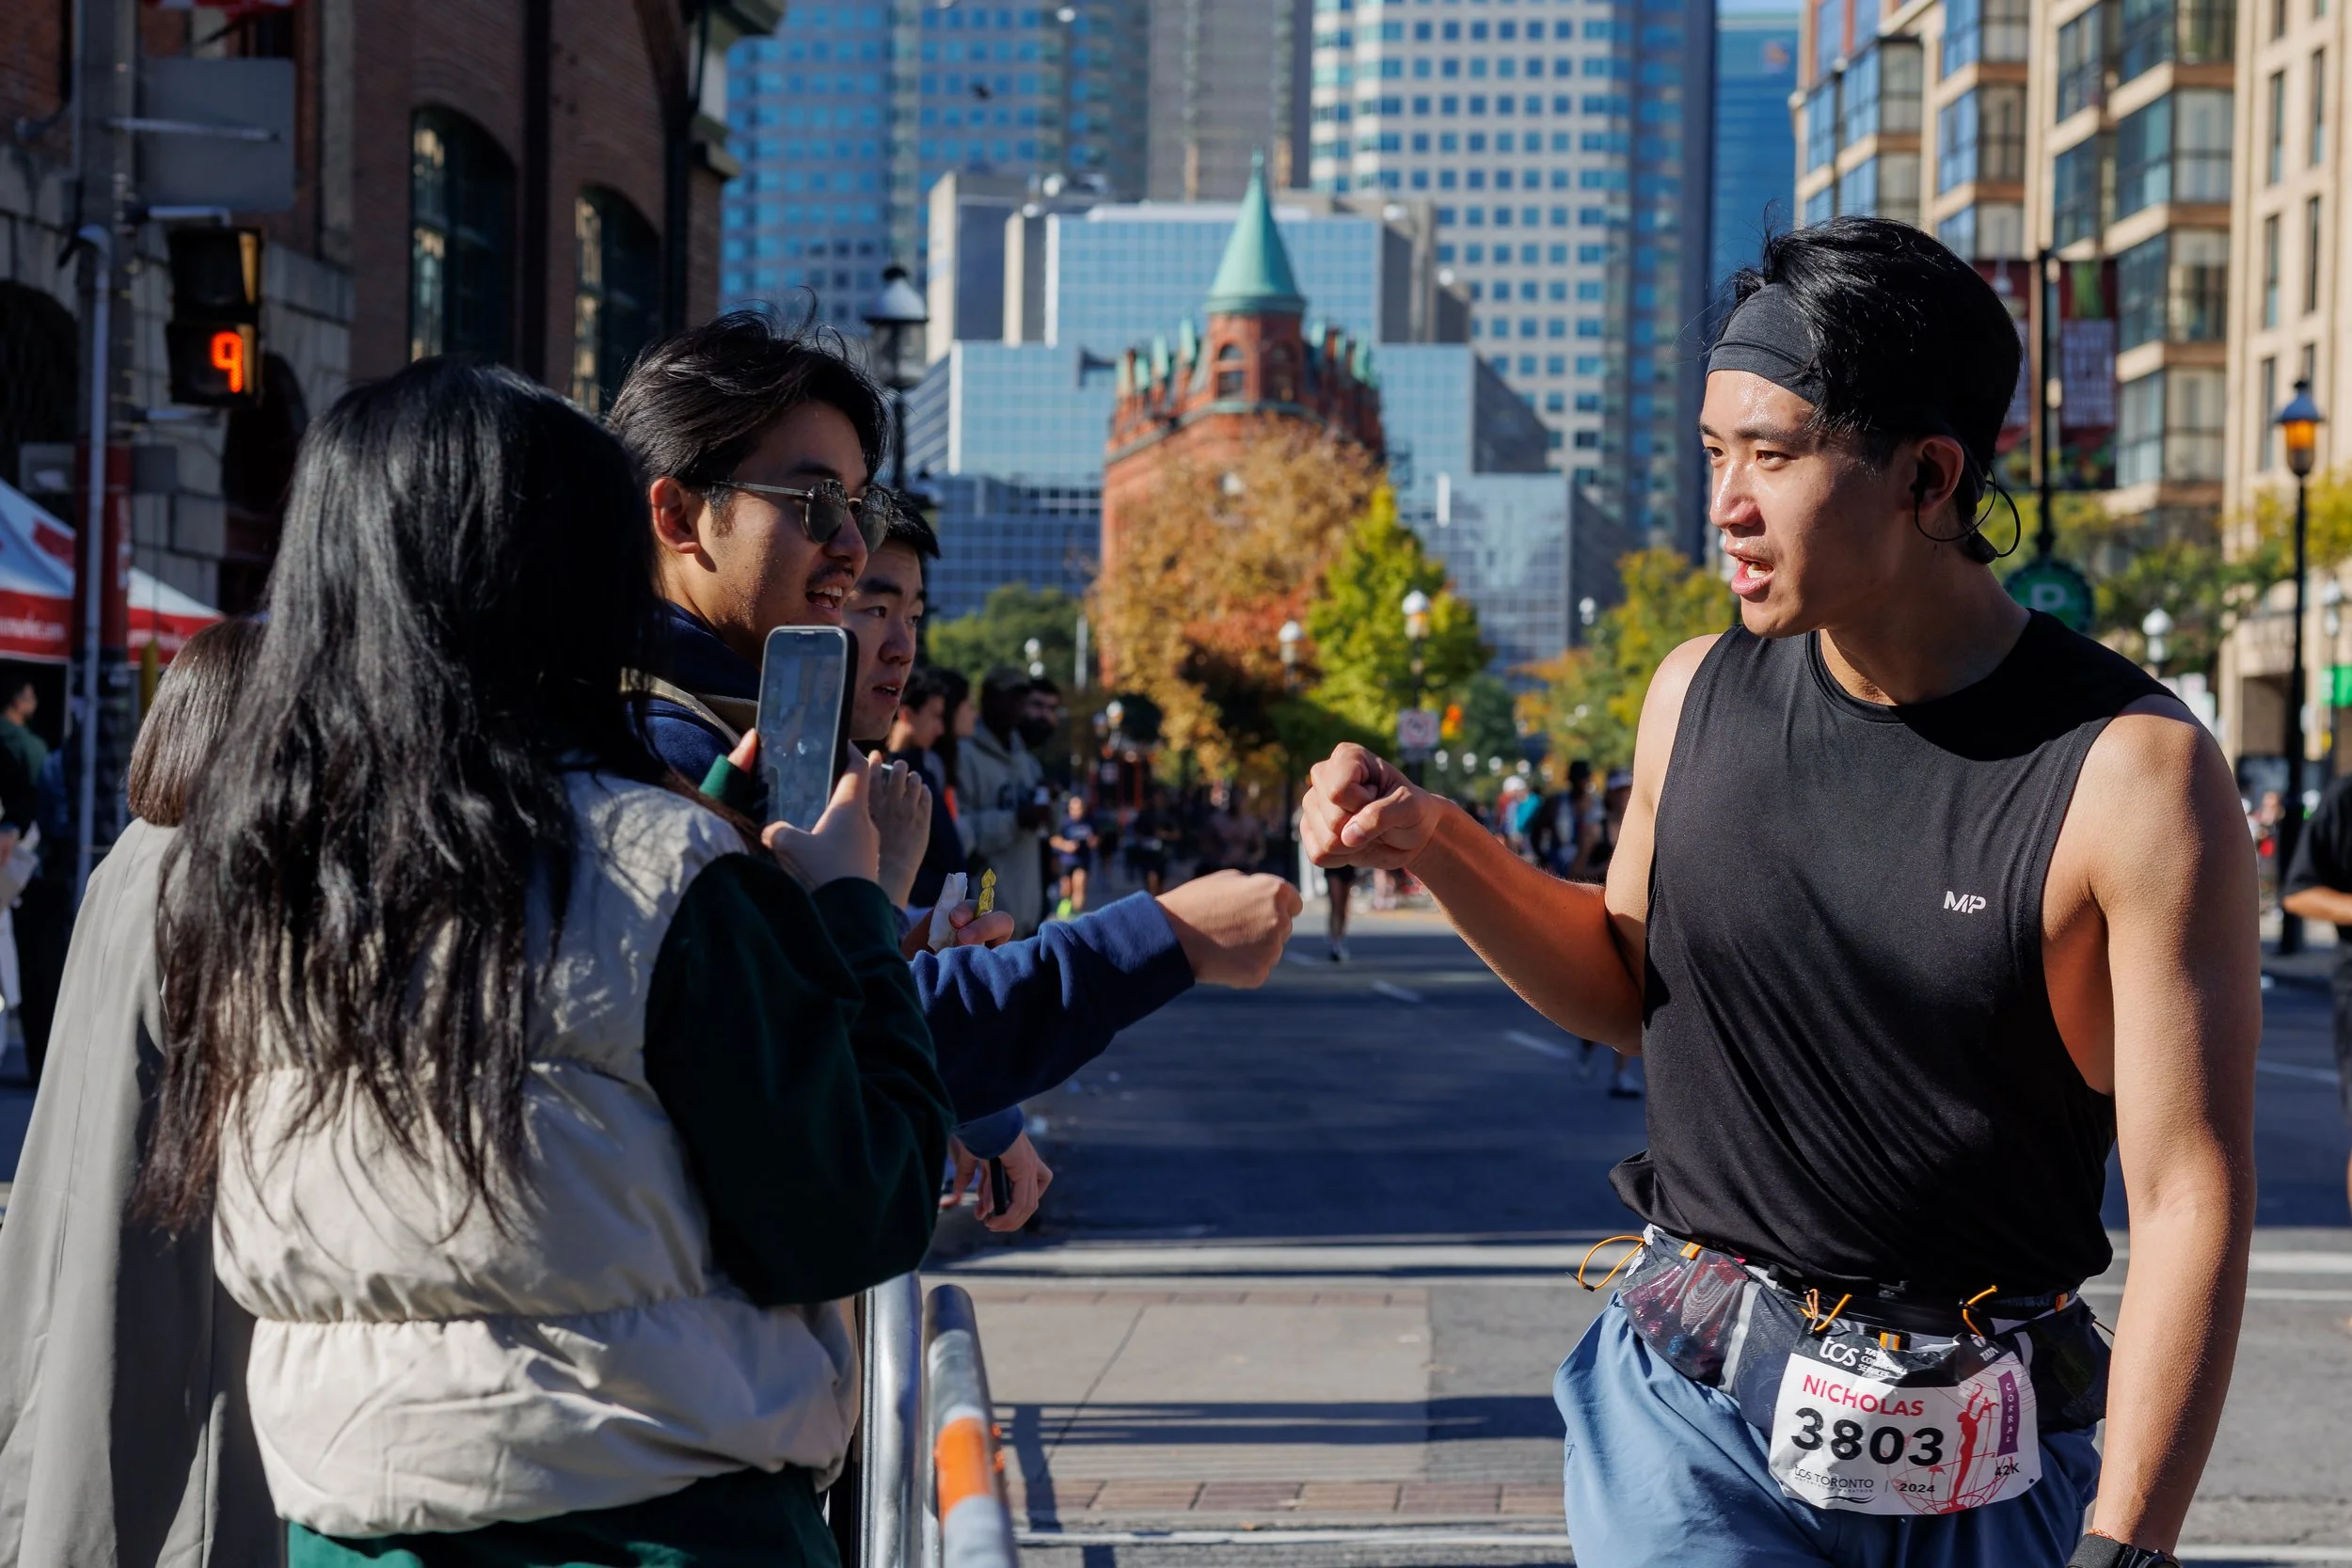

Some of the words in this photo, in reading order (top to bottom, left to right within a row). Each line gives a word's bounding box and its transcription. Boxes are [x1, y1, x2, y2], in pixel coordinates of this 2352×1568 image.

[212, 332, 243, 393] 9
[2031, 583, 2066, 611] P
[1943, 890, 1987, 914] MP
[1979, 1346, 1999, 1362] TATA
[1803, 1374, 1925, 1417] NICHOLAS
[2005, 1382, 2014, 1443] CORRAL
[1790, 1407, 1945, 1466] 3803
[1814, 1473, 1874, 1489] TORONTO
[1994, 1462, 2020, 1477] 42K
[1899, 1482, 1936, 1494] 2024
